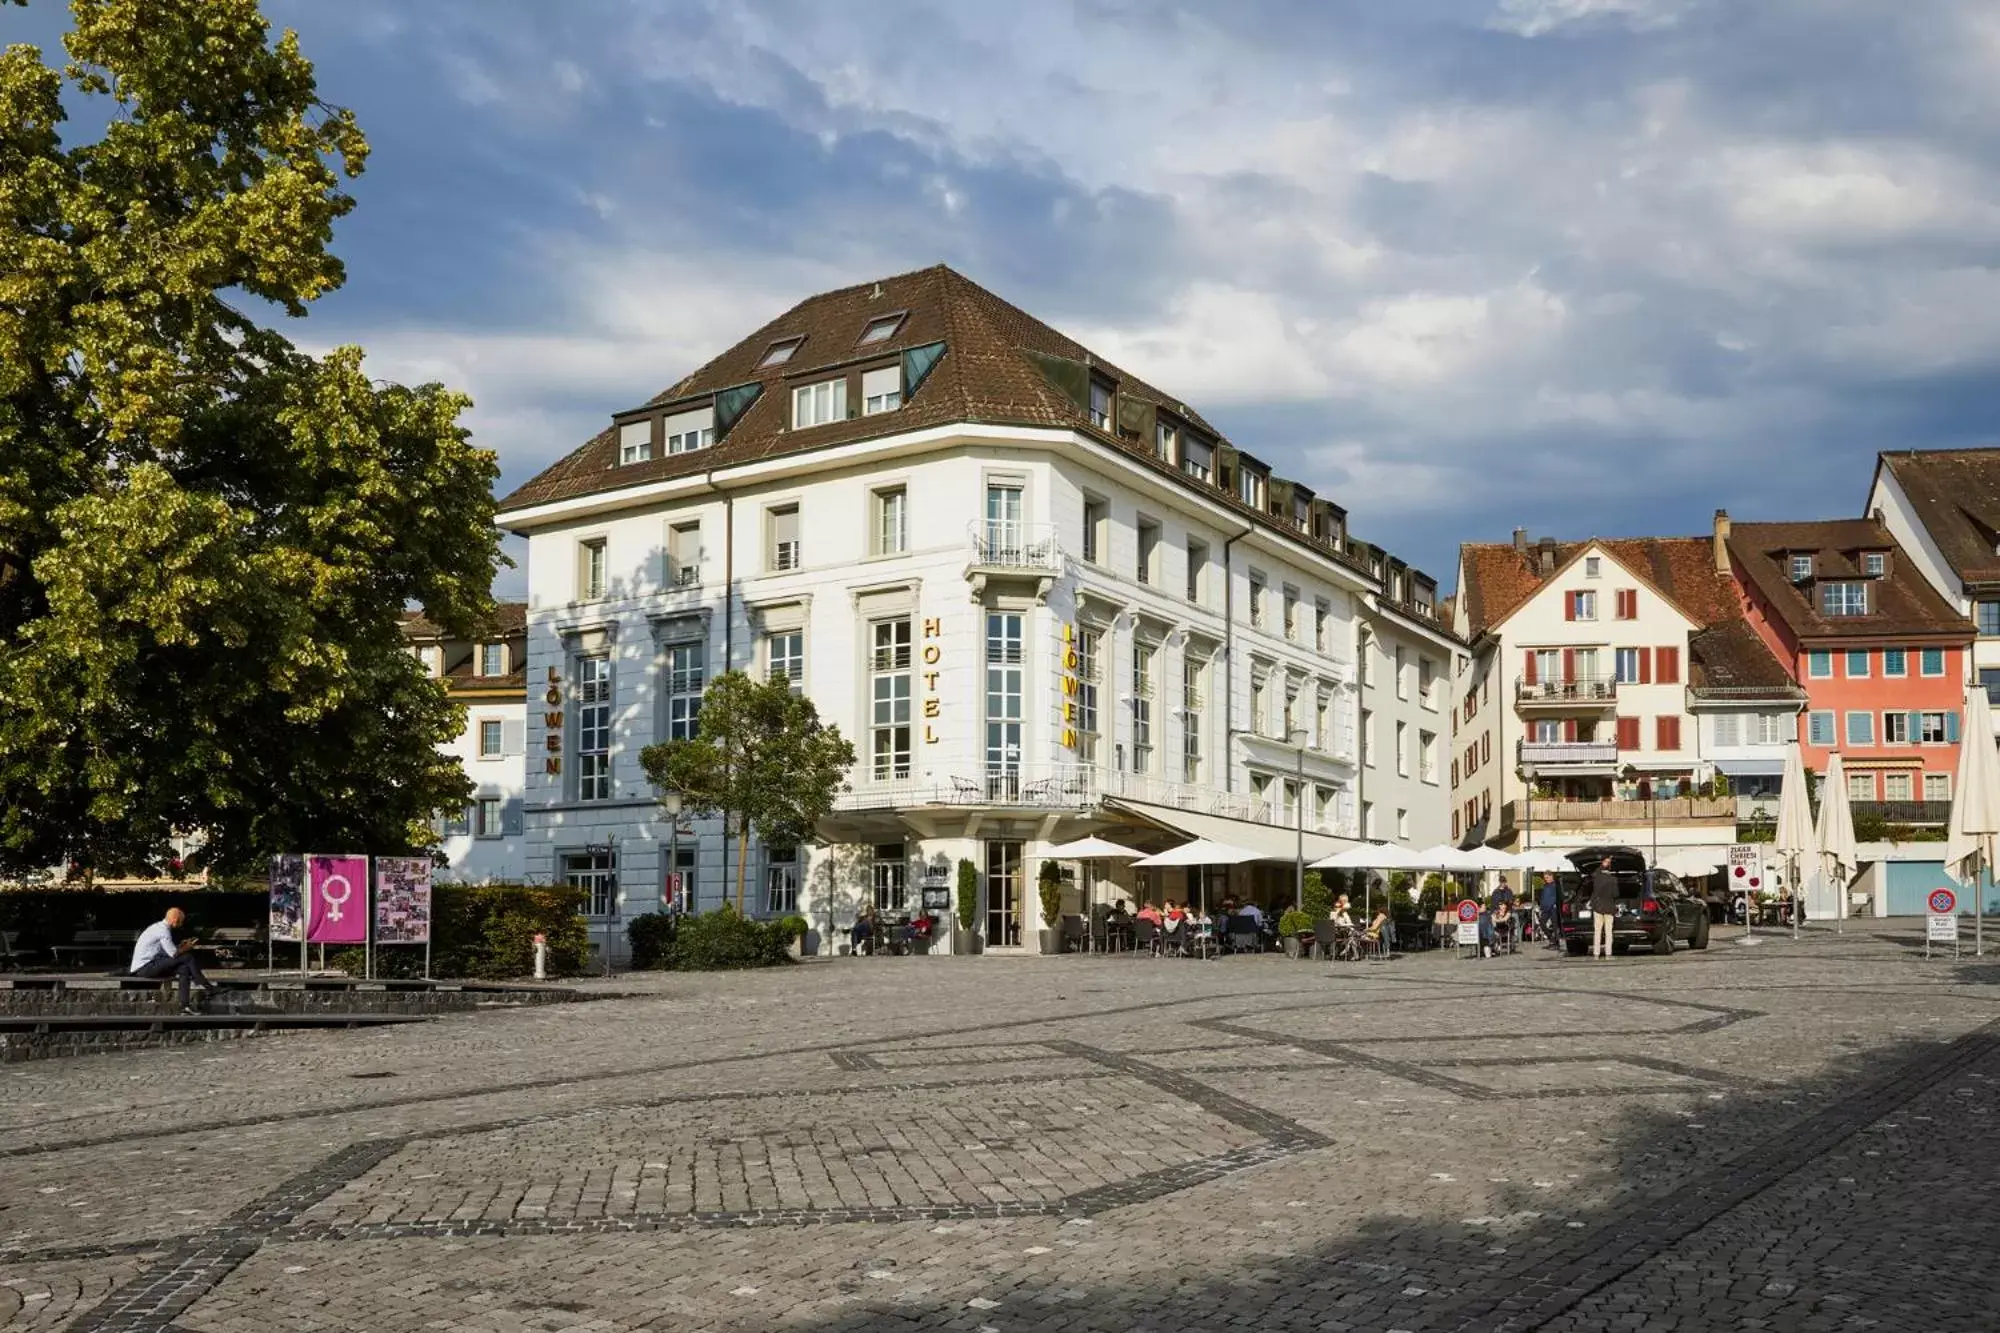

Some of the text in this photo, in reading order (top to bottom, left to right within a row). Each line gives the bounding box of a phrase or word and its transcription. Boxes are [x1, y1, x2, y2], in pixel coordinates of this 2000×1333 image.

[544, 666, 564, 775] LÖWEN
[922, 616, 941, 744] HOTEL
[1060, 624, 1078, 750] LÖWEN
